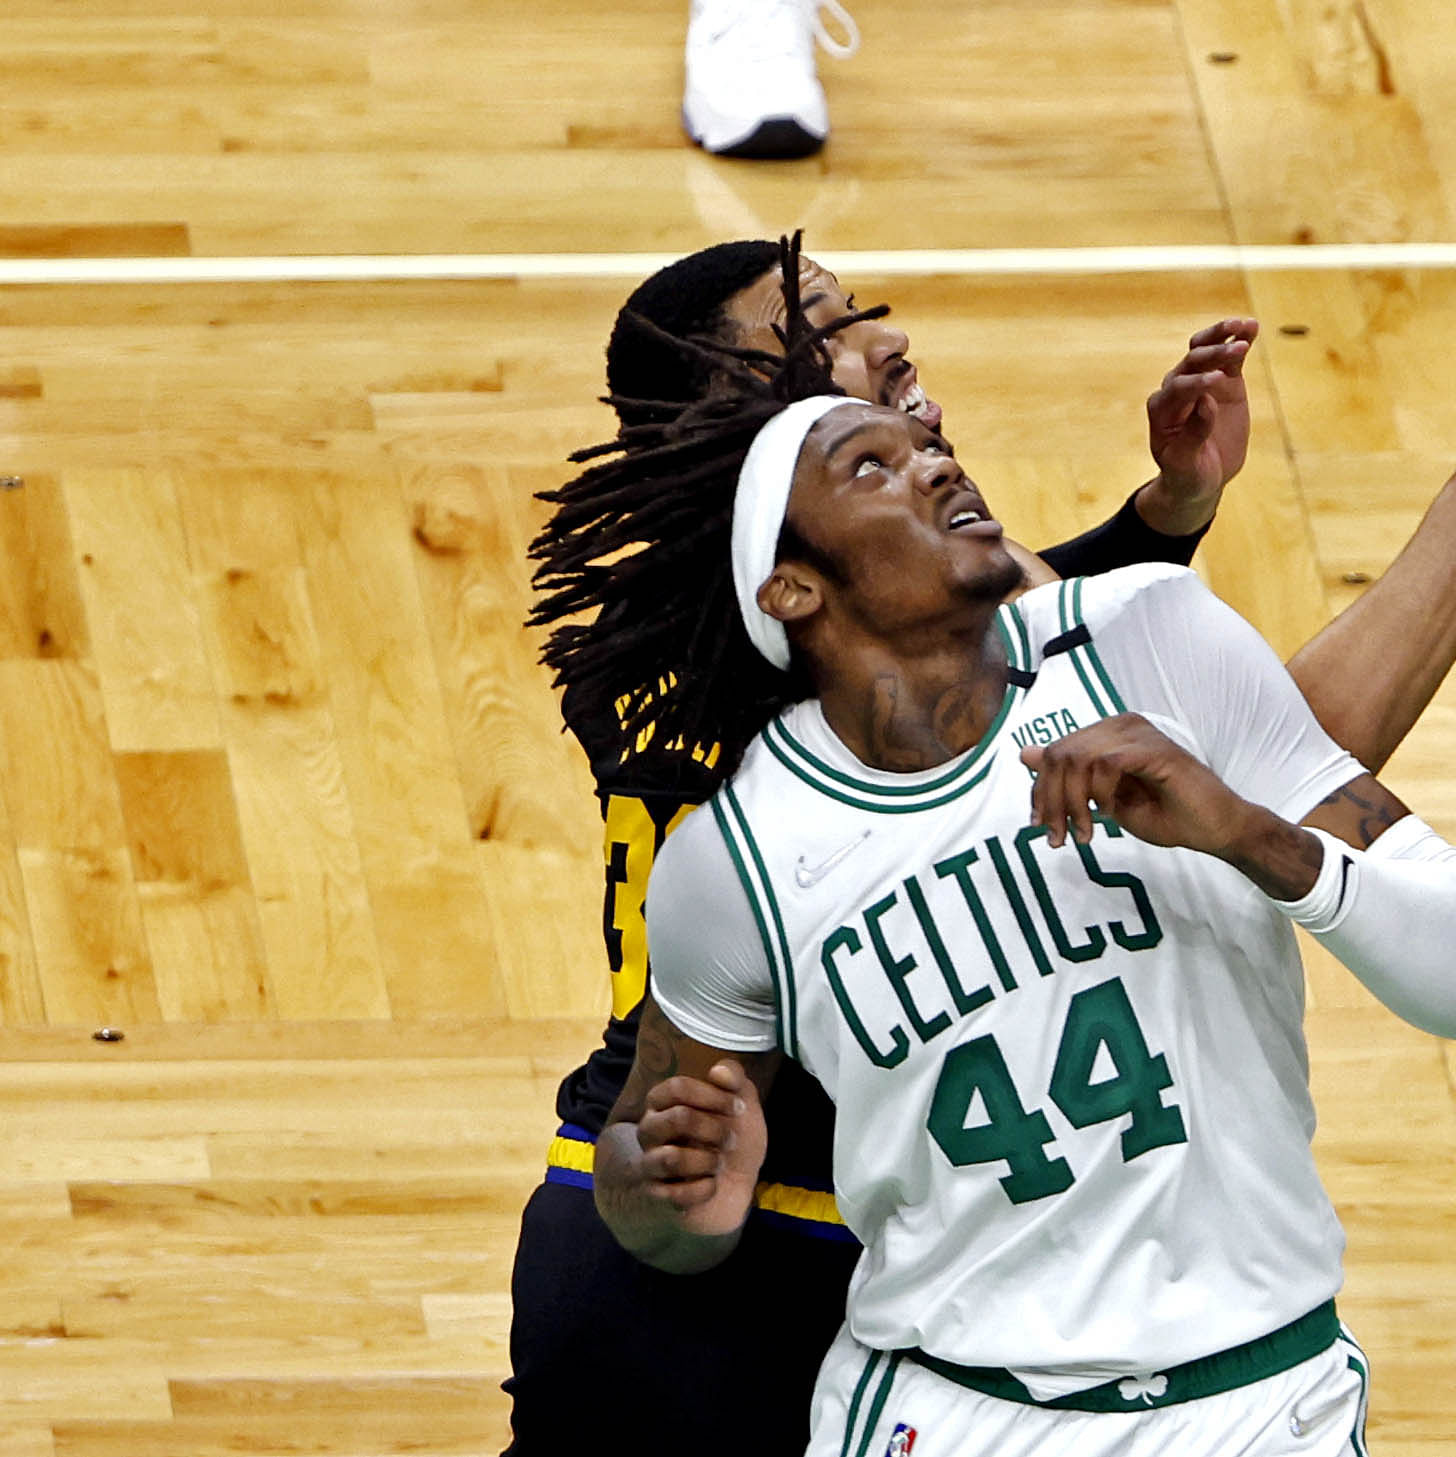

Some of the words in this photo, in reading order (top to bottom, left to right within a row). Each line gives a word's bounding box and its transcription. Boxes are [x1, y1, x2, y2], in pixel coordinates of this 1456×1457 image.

[1011, 707, 1080, 749] VISTA
[821, 807, 1164, 1070] CELTICS
[927, 975, 1189, 1205] 44
